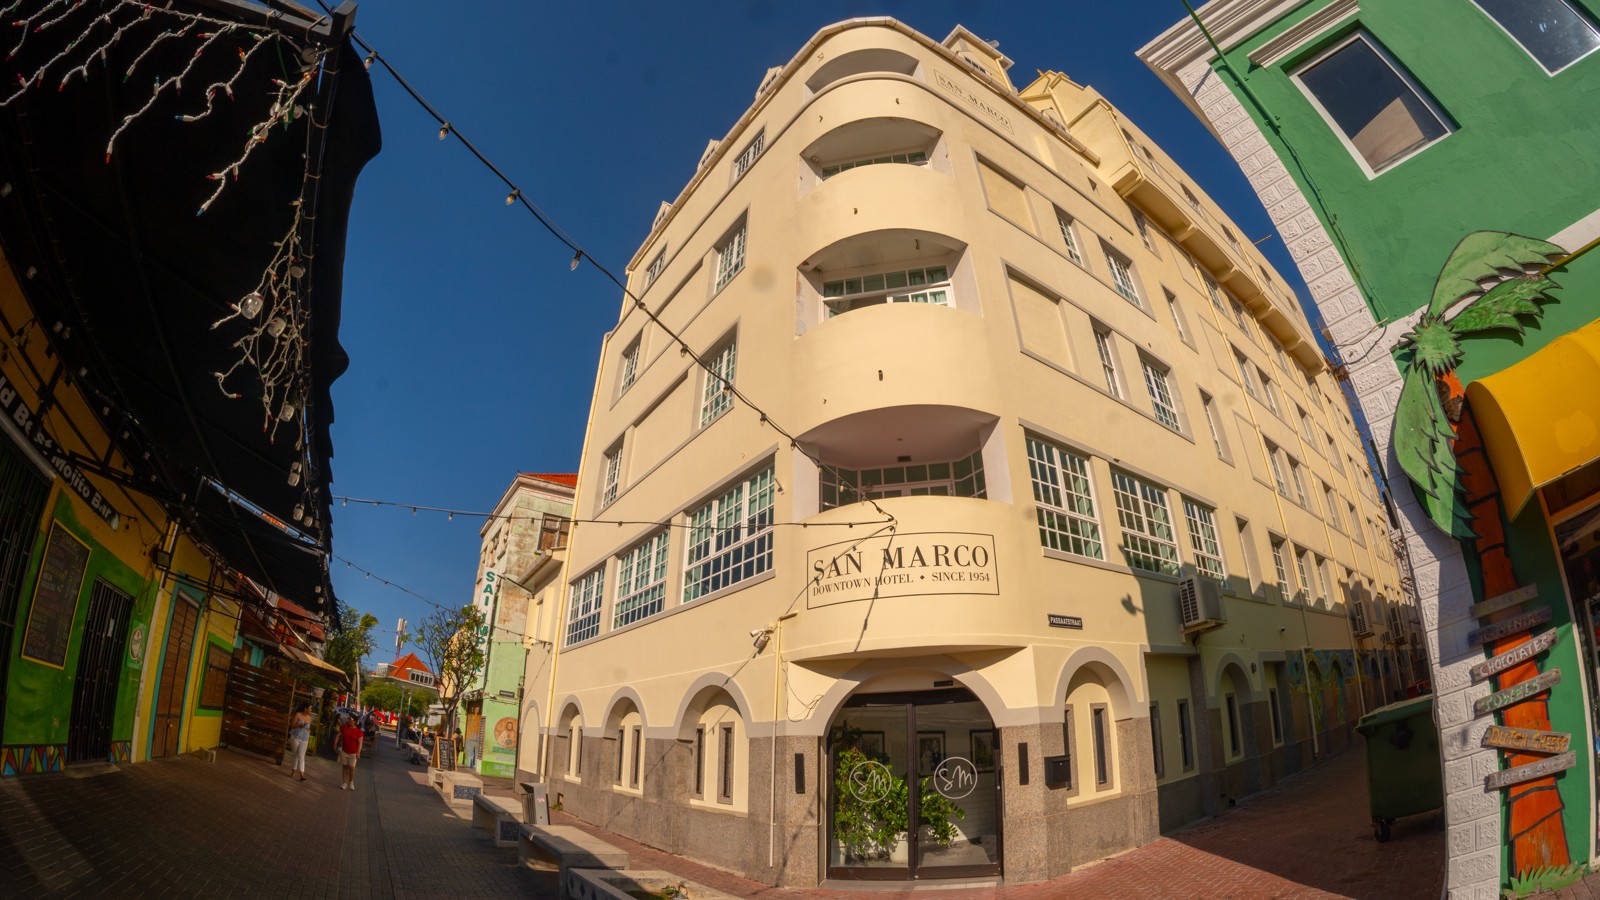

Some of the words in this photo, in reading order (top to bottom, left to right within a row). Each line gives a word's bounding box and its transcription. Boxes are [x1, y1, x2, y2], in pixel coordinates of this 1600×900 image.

[50, 447, 91, 499] Mojito
[91, 491, 114, 519] Bar
[812, 551, 864, 583] SAN
[881, 544, 989, 570] MARCO
[483, 571, 496, 607] SAI
[812, 576, 872, 597] DOWNTOWN
[874, 573, 914, 587] HOTEL
[931, 571, 966, 582] SINCE
[968, 571, 991, 582] 1954
[1479, 635, 1550, 677] CHOCOLATES
[1481, 679, 1540, 712] TOWELS
[1489, 727, 1529, 748] DUTCH
[1531, 733, 1569, 751] CHEESE
